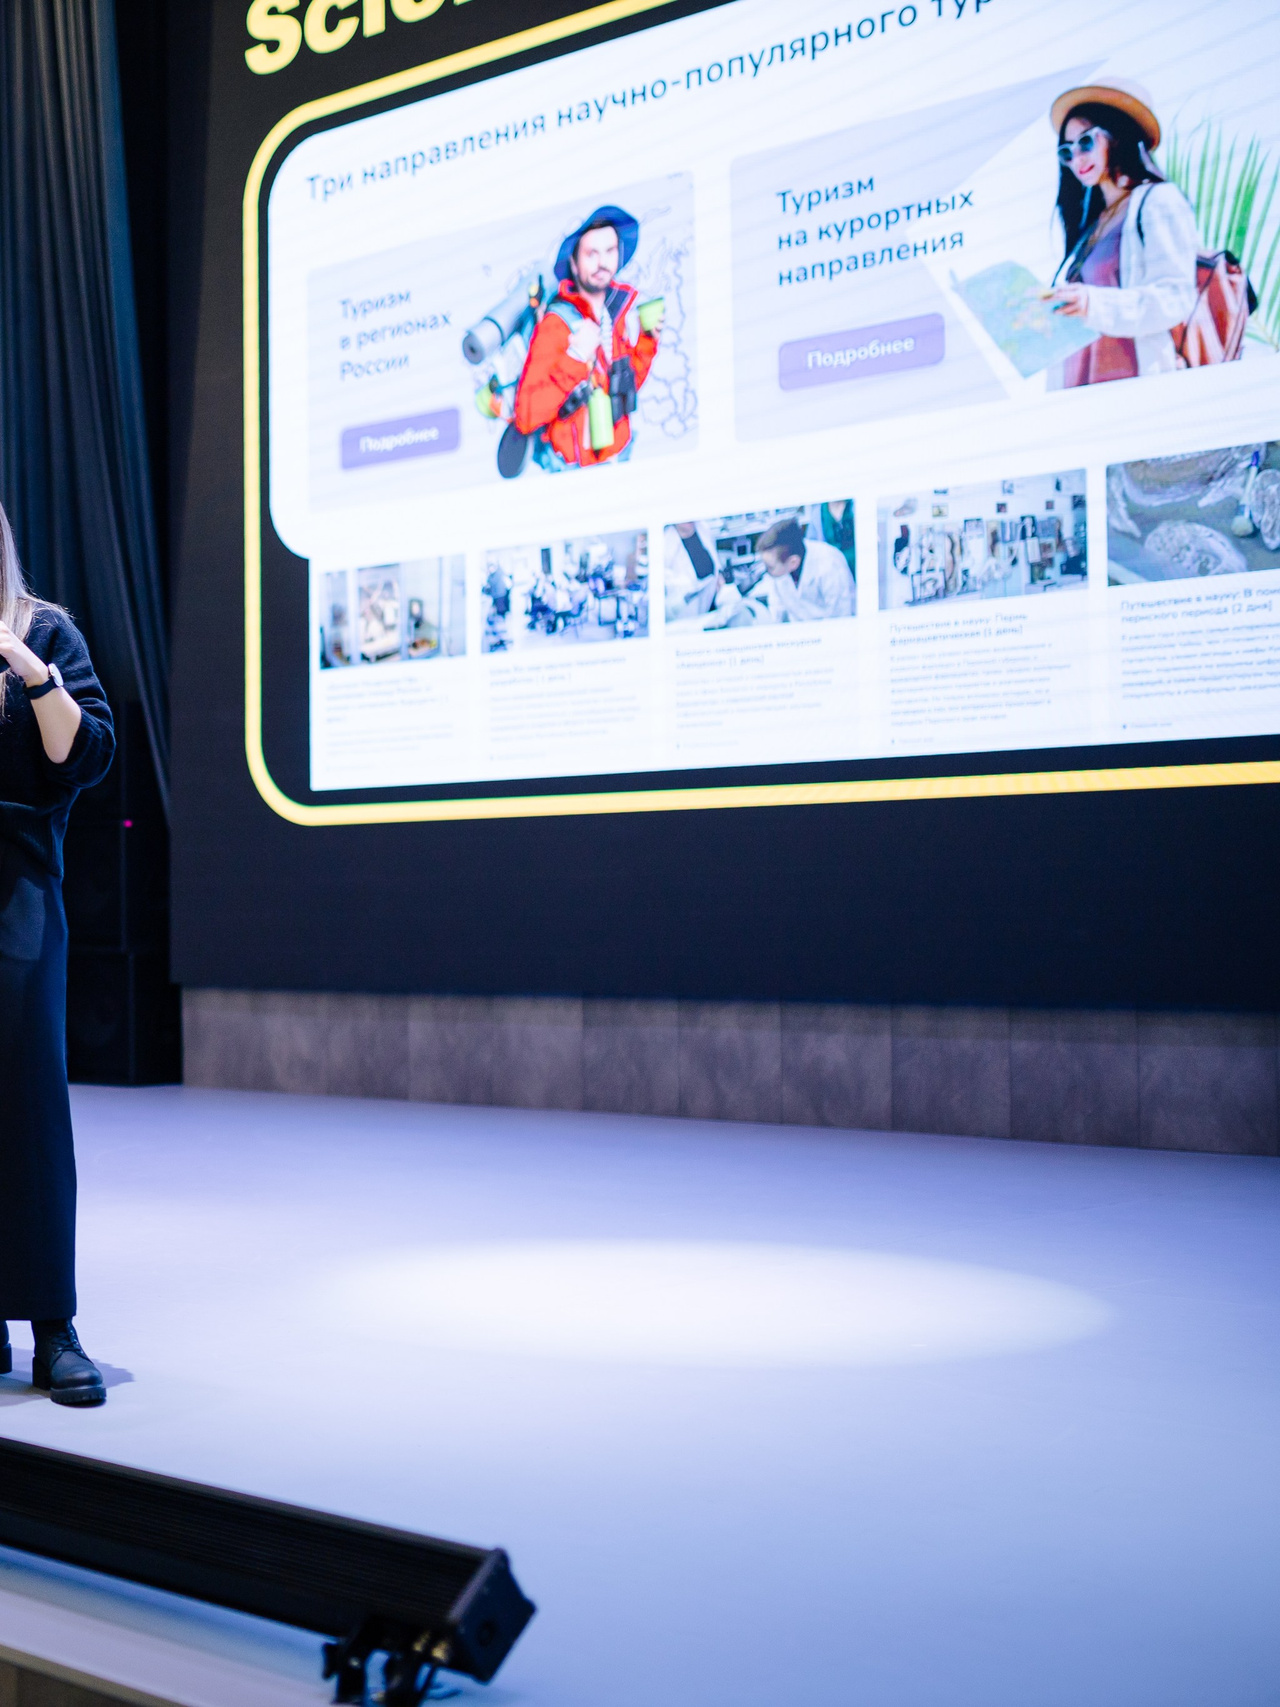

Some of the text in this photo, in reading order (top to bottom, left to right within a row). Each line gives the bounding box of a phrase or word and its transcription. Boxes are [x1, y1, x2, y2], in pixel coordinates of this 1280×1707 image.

[306, 170, 353, 203] Три
[362, 112, 547, 186] направления
[557, 5, 917, 132] научно-популярного
[776, 176, 875, 214] Туризм
[777, 190, 974, 251] на курортных
[777, 230, 965, 287] направления
[339, 290, 412, 321] Туризм
[340, 311, 452, 350] в регионах
[340, 354, 410, 382] России
[806, 335, 916, 370] Подробнее
[360, 427, 440, 453] Подробнее
